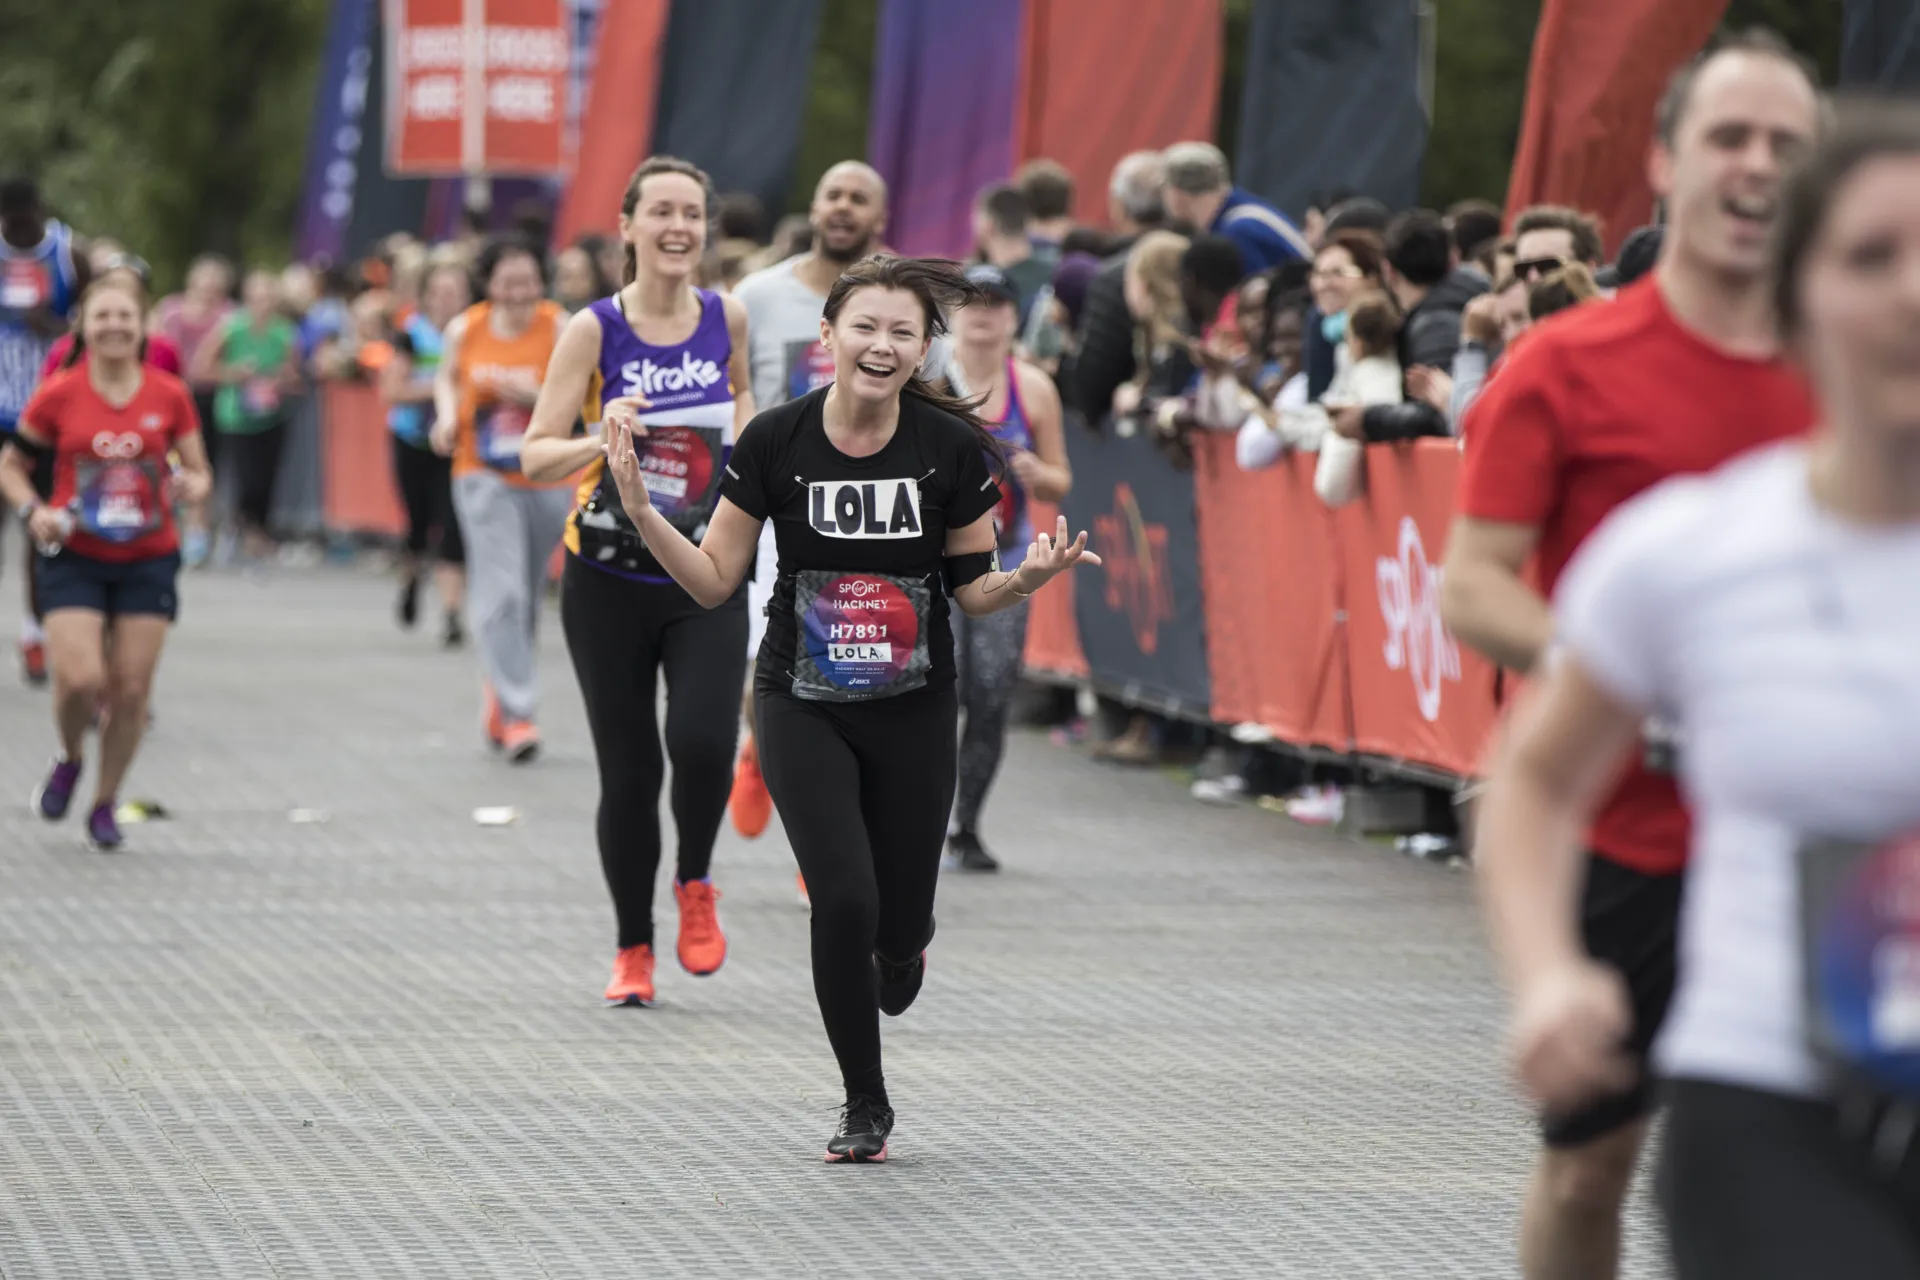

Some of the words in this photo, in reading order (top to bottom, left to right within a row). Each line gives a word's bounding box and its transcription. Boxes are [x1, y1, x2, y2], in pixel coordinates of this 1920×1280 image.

[621, 350, 722, 396] Stroke
[653, 391, 705, 405] ssociation
[812, 482, 920, 535] LOLA
[839, 580, 881, 597] SPORT
[833, 599, 889, 610] HACKNEY
[830, 623, 887, 639] H7891
[834, 646, 879, 660] LOLA
